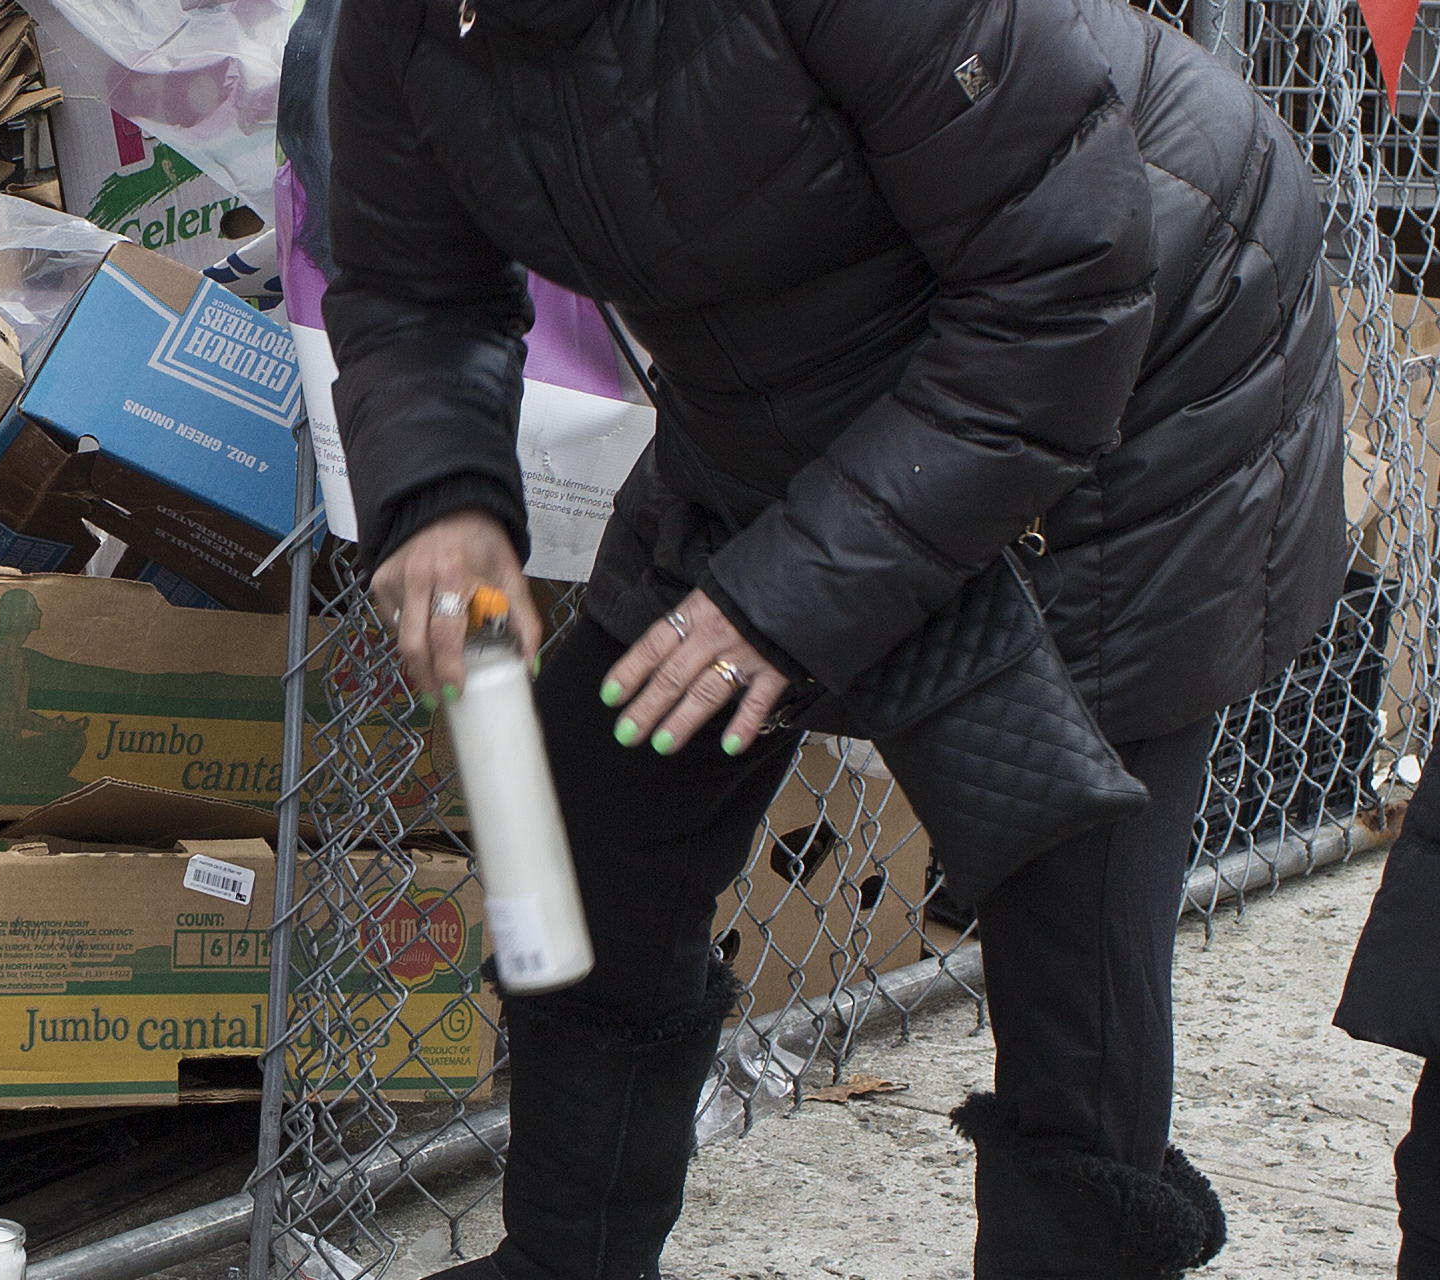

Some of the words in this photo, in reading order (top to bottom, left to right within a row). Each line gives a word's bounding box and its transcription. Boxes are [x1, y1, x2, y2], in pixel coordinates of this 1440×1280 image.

[212, 298, 253, 320] PRODUCE
[184, 324, 294, 394] CHURCH
[123, 398, 174, 432] ONIONS
[175, 424, 222, 453] GREEN
[256, 460, 270, 473] 4
[96, 720, 204, 760] Jumbo
[176, 913, 226, 927] COUNT:
[210, 939, 222, 957] 6
[238, 939, 250, 958] 9
[20, 1006, 129, 1052] Jumbo
